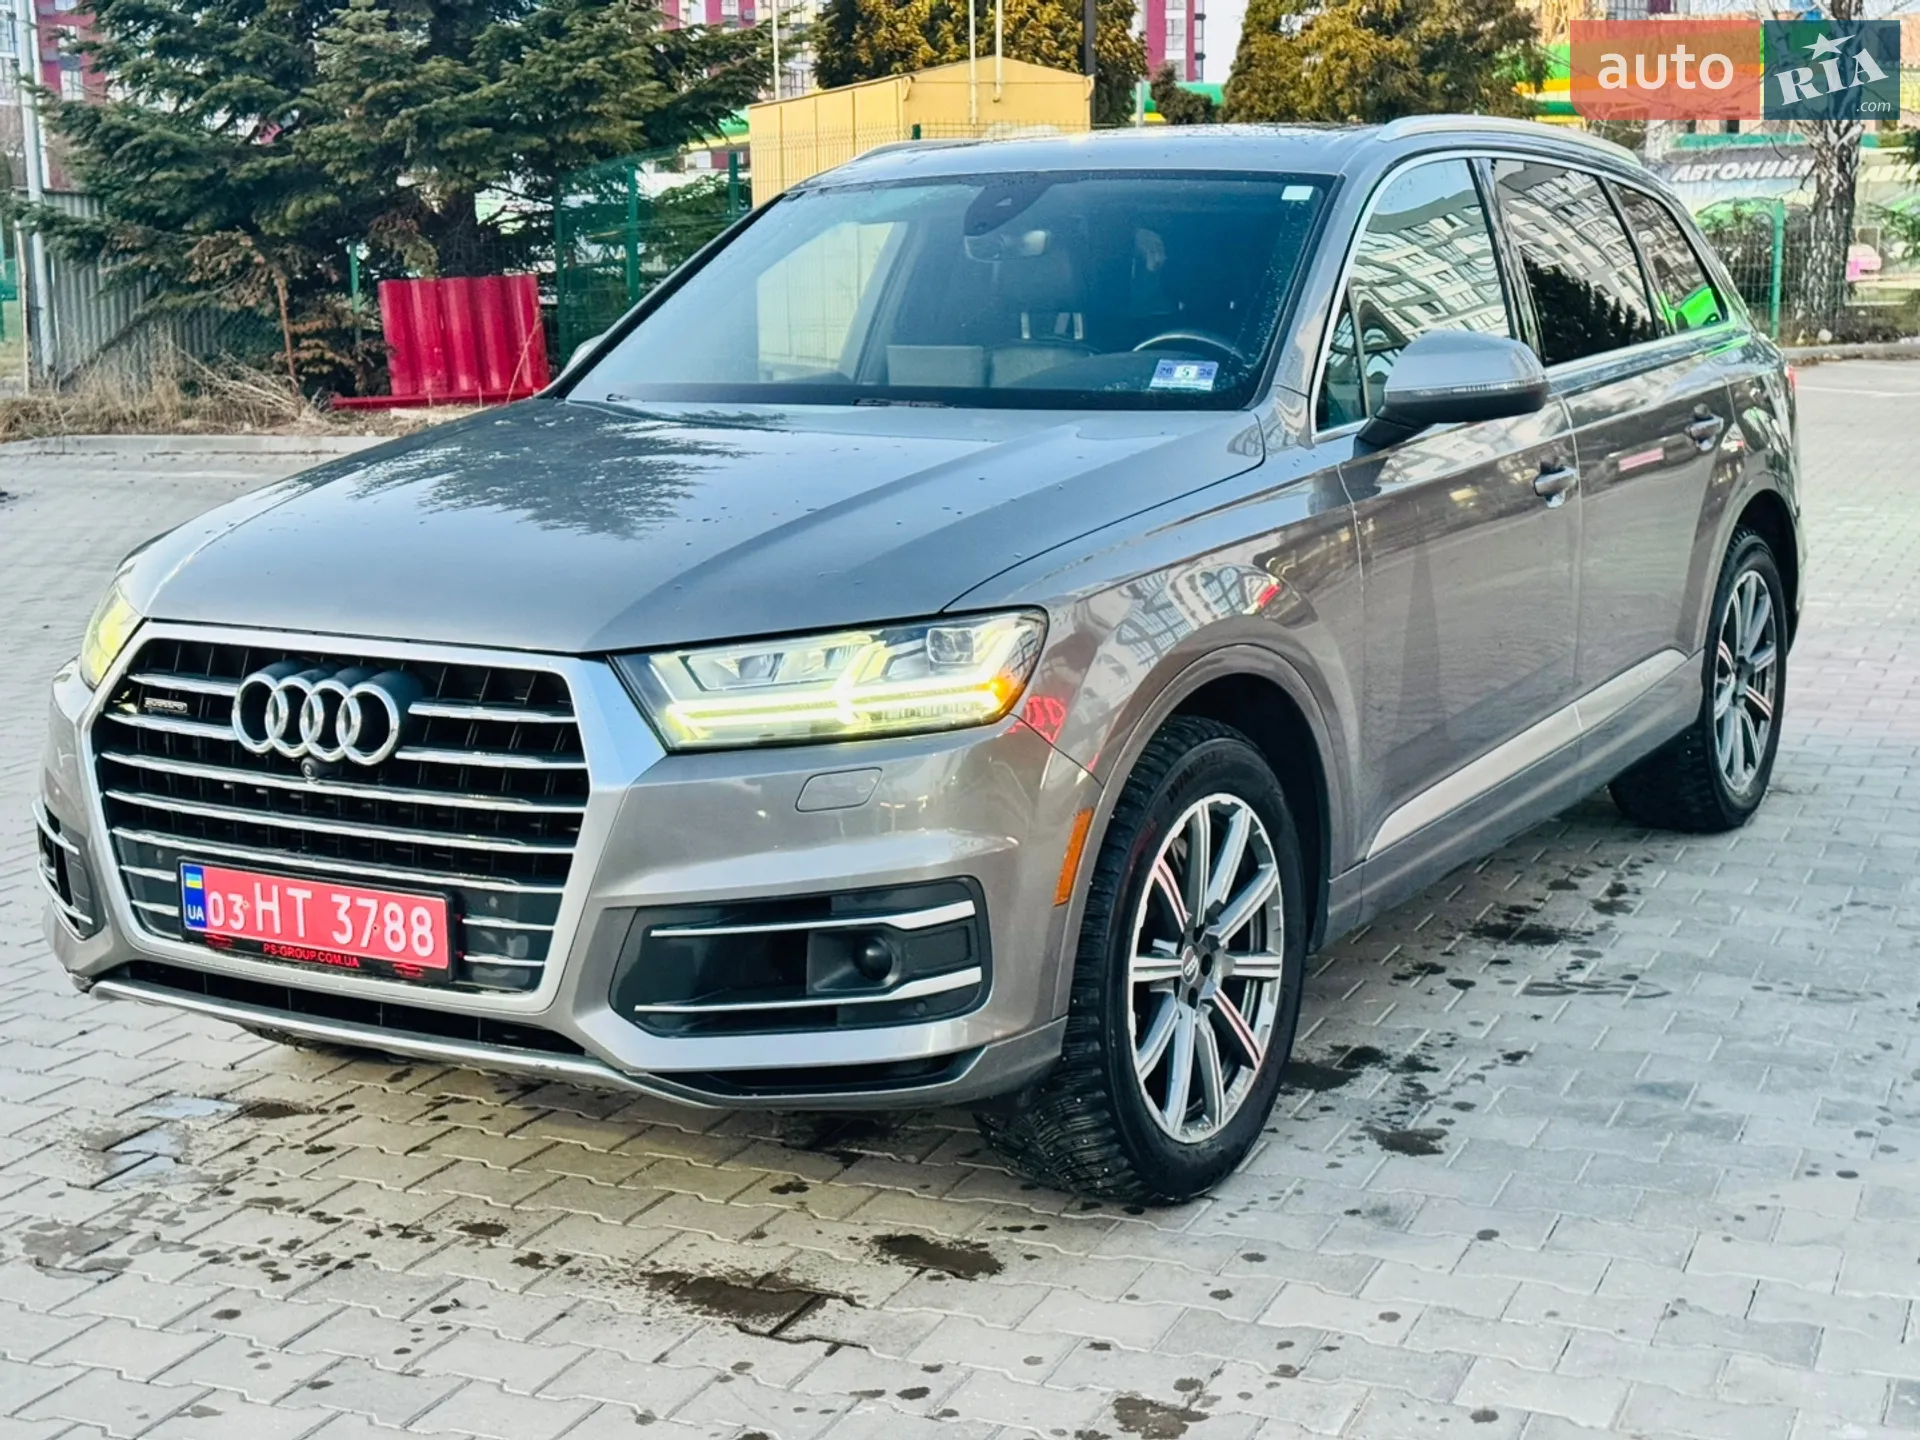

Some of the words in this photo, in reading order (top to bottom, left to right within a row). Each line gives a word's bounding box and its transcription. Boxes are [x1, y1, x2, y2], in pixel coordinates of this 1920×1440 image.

[1670, 153, 1818, 182] АВТОМИЙК
[187, 904, 205, 921] UA
[208, 891, 245, 930] 03
[254, 882, 312, 939] HT
[330, 893, 435, 957] 3788
[262, 942, 360, 968] PS-GROUP.COM.UA
